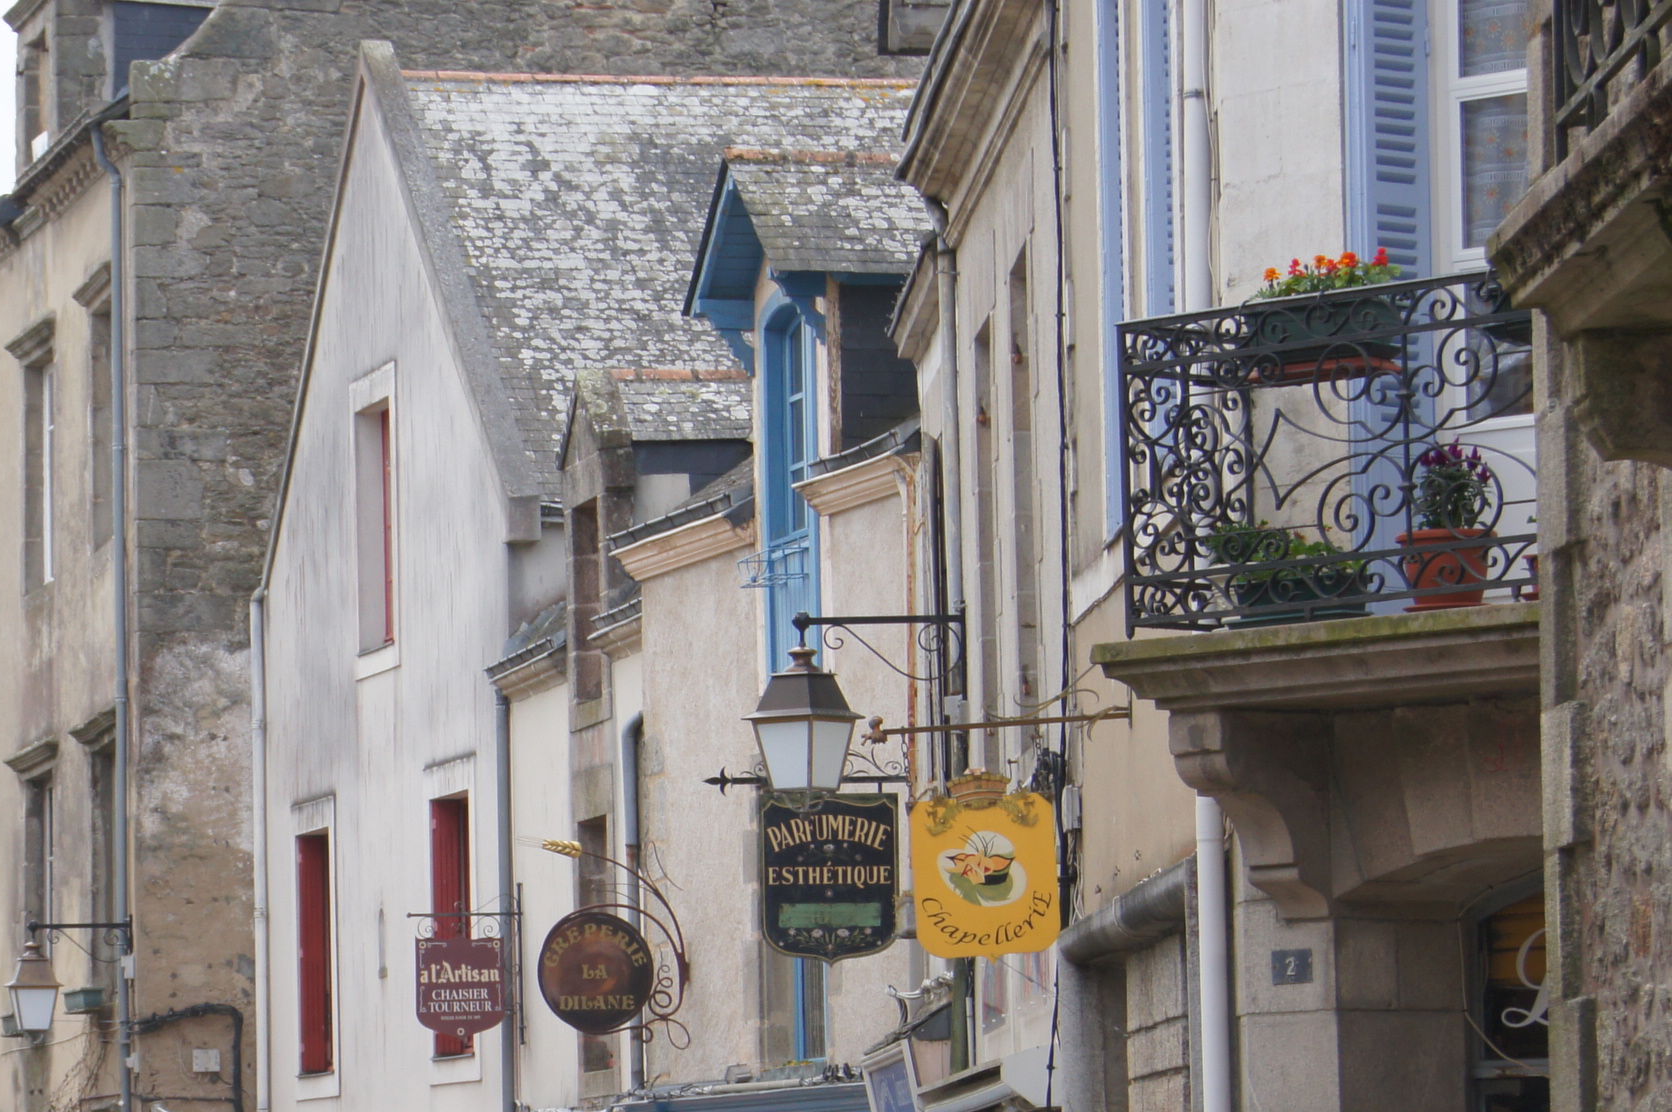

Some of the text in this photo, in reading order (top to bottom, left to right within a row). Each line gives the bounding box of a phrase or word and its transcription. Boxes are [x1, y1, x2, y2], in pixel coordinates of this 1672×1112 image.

[767, 814, 891, 853] PARFUMERIE
[768, 861, 892, 888] ESTHÉTIQUE
[420, 960, 500, 984] a l'Artisan
[582, 963, 608, 979] LA
[1285, 956, 1296, 977] 2
[431, 988, 489, 1001] CHAISIER
[428, 1001, 492, 1013] TOURNEUR
